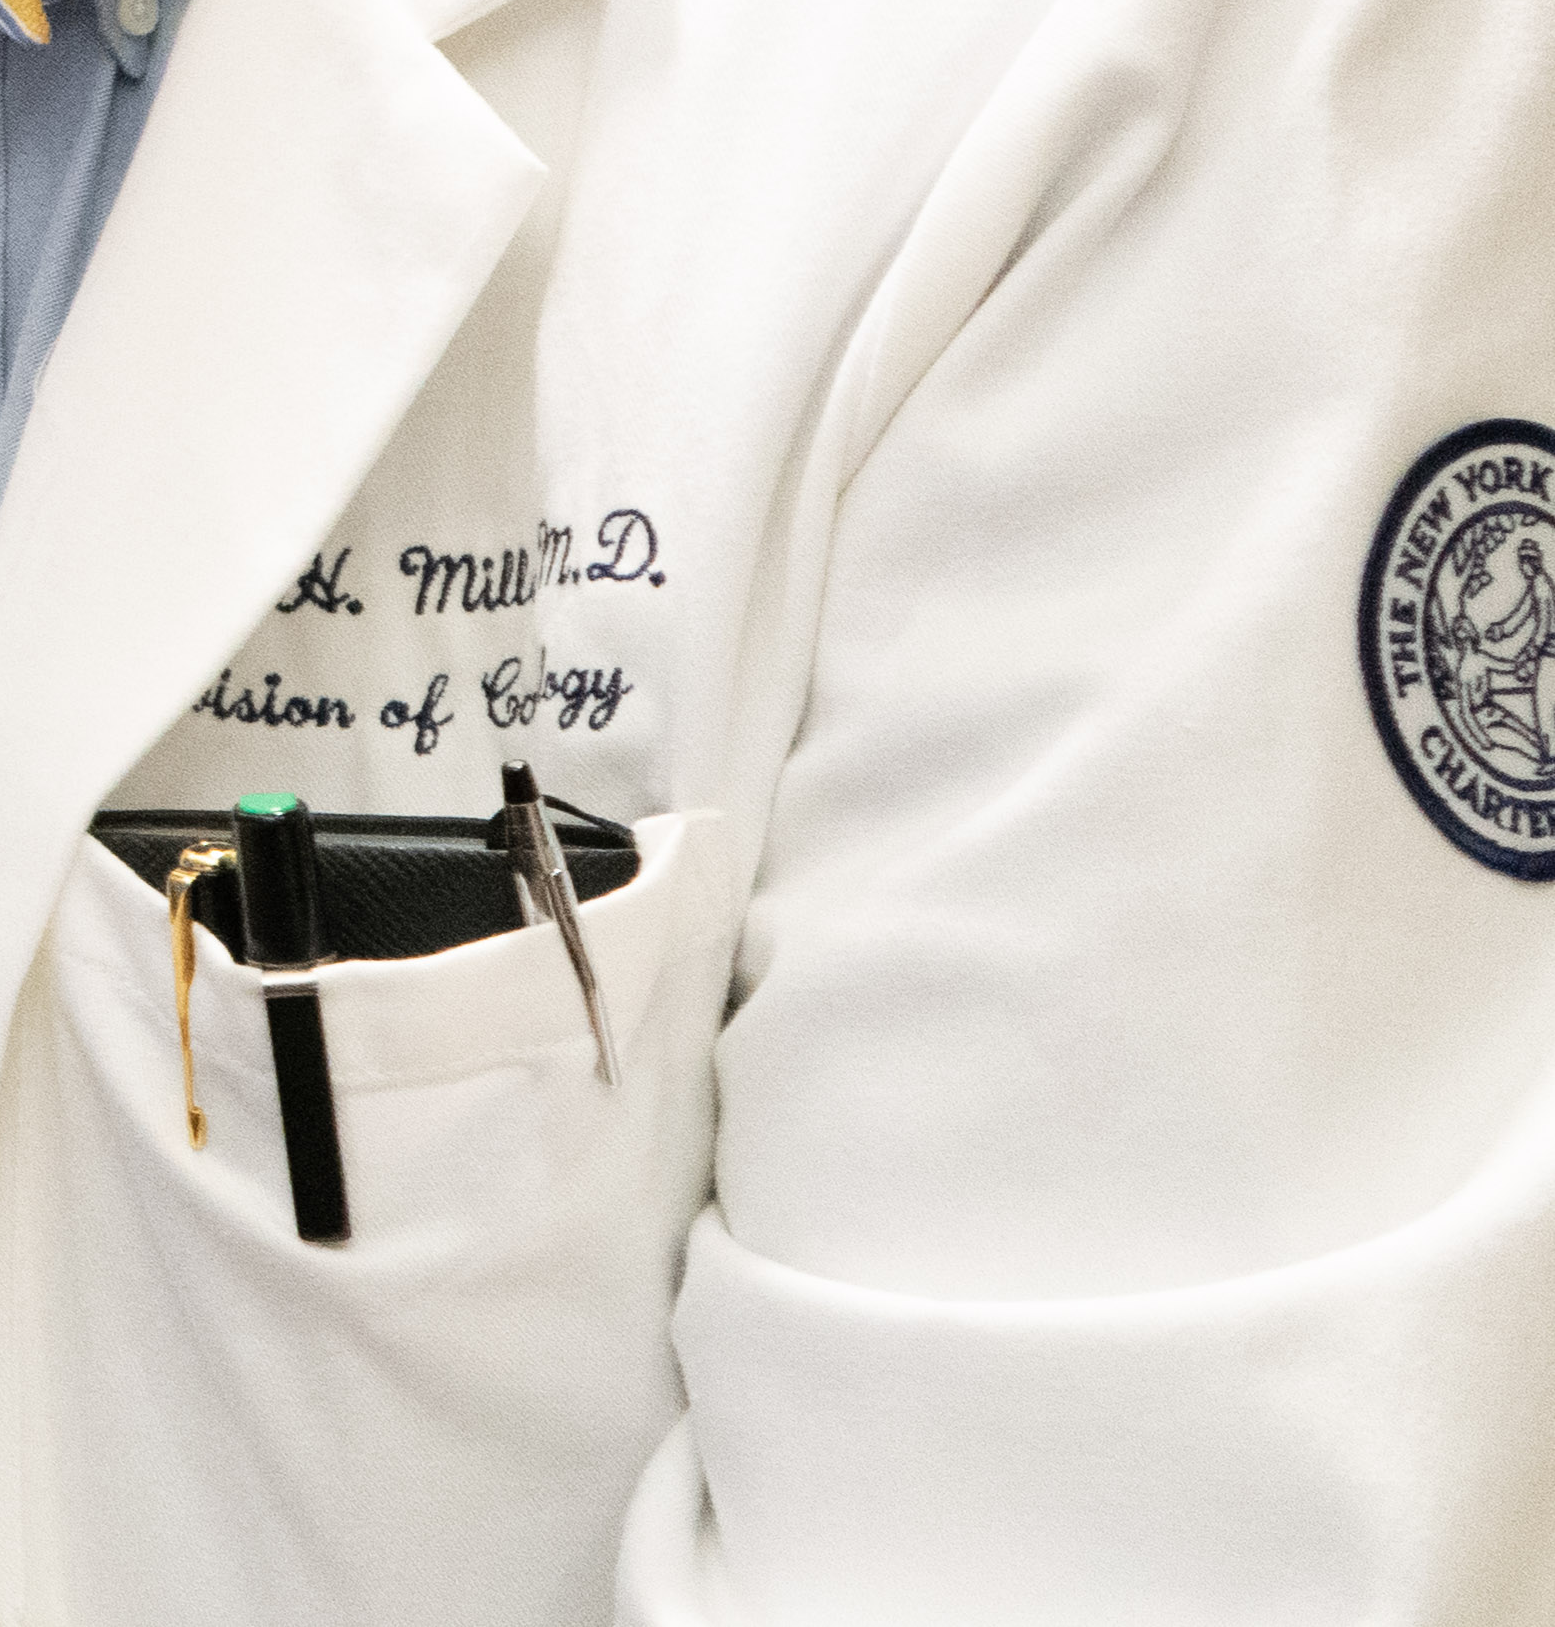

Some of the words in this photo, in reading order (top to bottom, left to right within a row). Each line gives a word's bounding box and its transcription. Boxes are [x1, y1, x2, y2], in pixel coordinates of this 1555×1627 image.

[1454, 456, 1555, 503] YORK
[1393, 484, 1455, 592] NEW
[1387, 596, 1425, 699] THE
[379, 672, 456, 757] of
[1420, 724, 1555, 839] CHARTE
